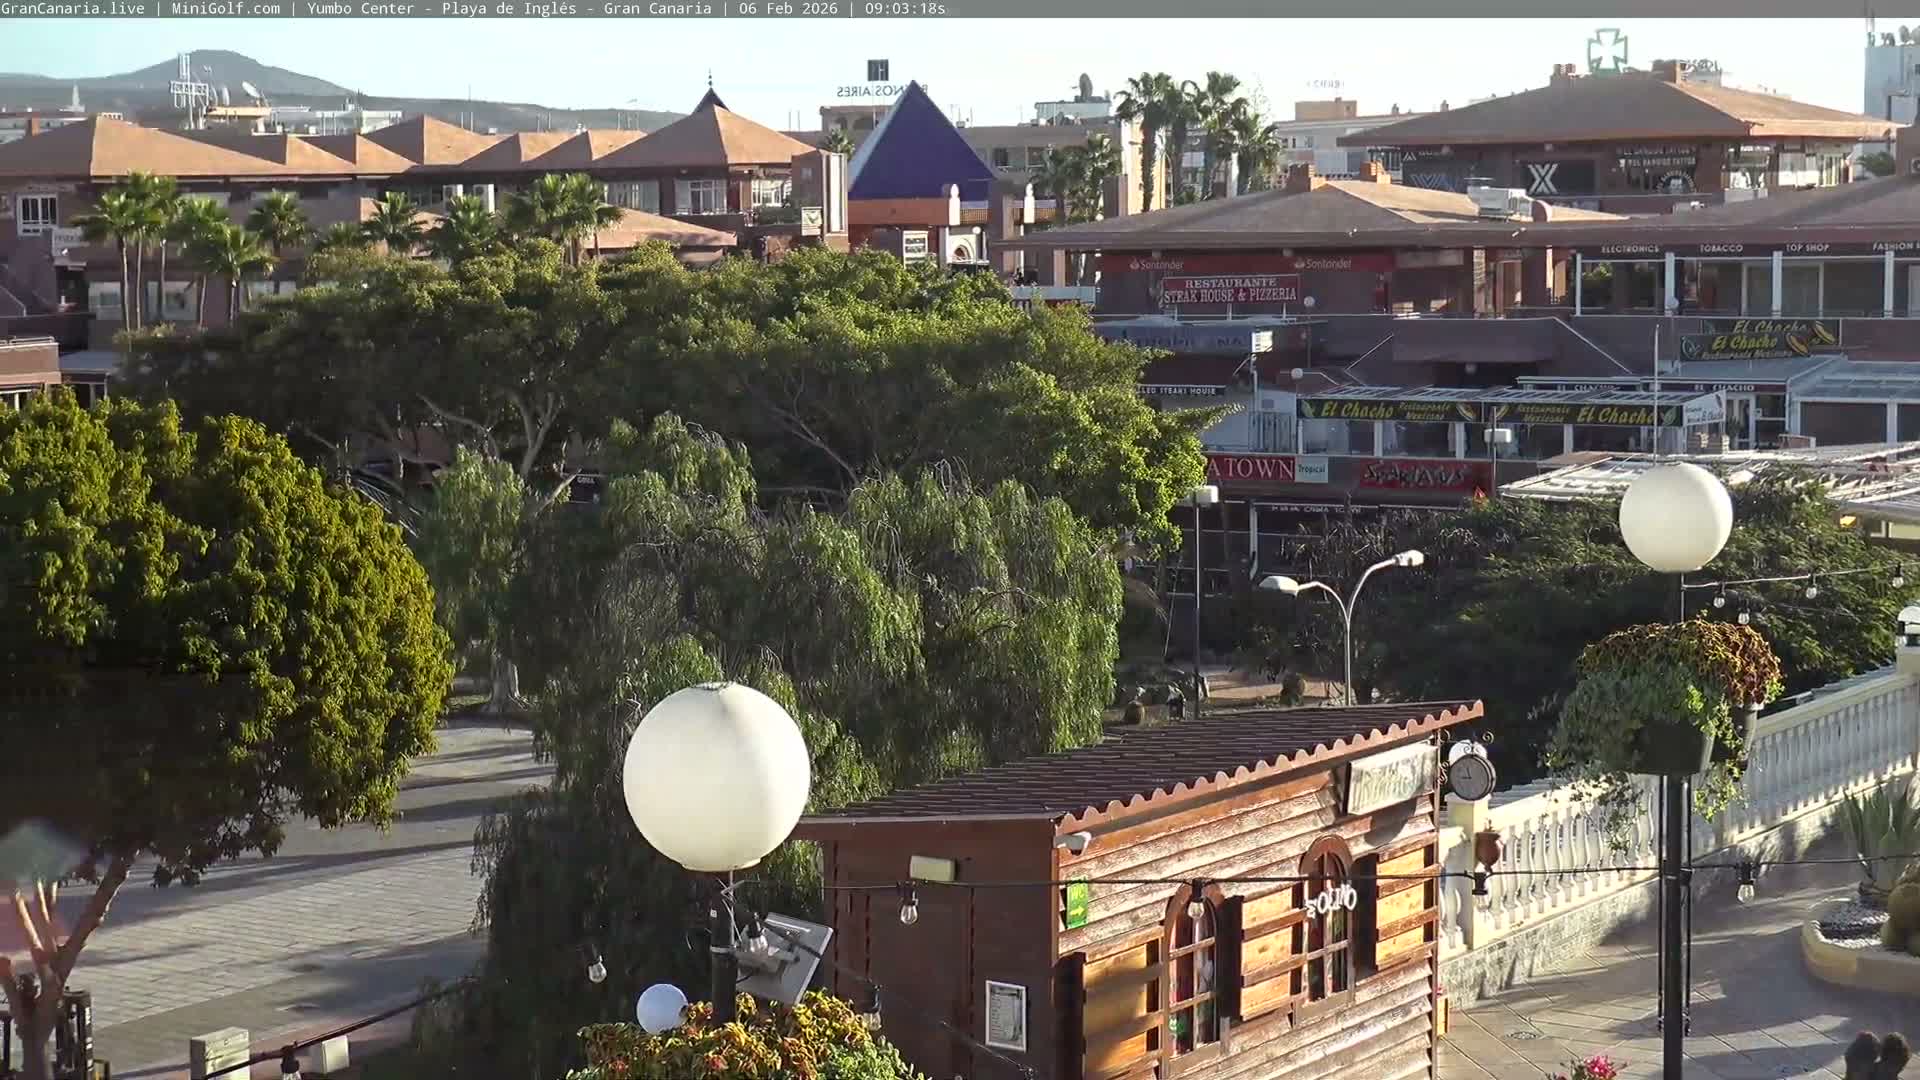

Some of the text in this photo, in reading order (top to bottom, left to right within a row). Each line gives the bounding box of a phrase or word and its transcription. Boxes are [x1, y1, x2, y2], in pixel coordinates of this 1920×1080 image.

[1601, 245, 1660, 253] ELECTRONICS
[1700, 244, 1744, 253] TOBACCO
[1786, 243, 1830, 252] TOP SHOP
[1873, 242, 1913, 251] FASHION
[1140, 259, 1184, 270] Santander
[1306, 258, 1351, 270] Santander
[1185, 277, 1277, 289] RESTAURANTE
[1164, 287, 1297, 304] STEAK HOUSE & PIZZERIA
[1732, 319, 1751, 334] El
[1711, 334, 1778, 350] El Chacho
[1189, 387, 1216, 395] HOUSE
[1713, 384, 1755, 392] CHACHO
[1321, 401, 1394, 418] El Chacho
[1576, 406, 1656, 424] El Chacho
[1224, 457, 1295, 480] TOWN
[1298, 462, 1326, 475] Tropical
